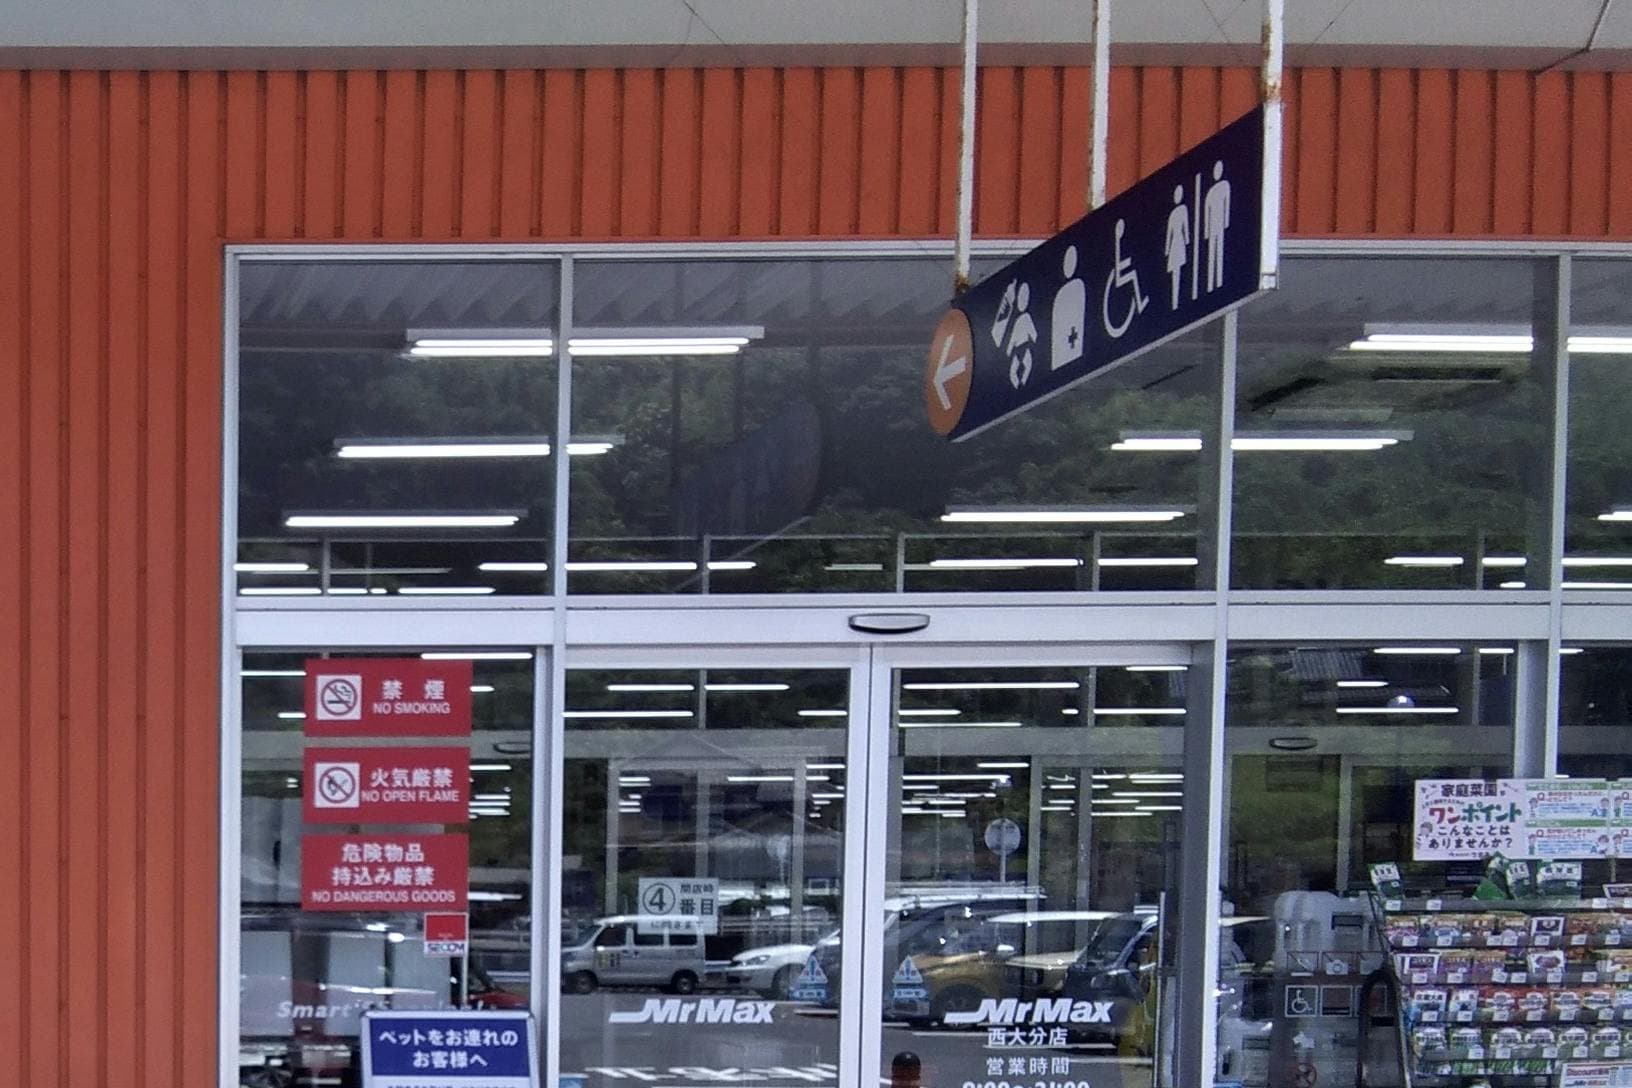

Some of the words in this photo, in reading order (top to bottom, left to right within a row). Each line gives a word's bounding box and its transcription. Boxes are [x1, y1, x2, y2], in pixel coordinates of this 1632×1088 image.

[381, 679, 445, 700] 禁煙
[372, 702, 391, 715] NO
[393, 703, 451, 715] SMOKING
[370, 767, 453, 789] 火気厳禁
[361, 790, 380, 802] NO
[382, 790, 417, 802] OPEN
[419, 790, 460, 802] FLAME
[1428, 801, 1523, 824] ワンポイント
[1437, 825, 1511, 837] こんなことは
[341, 843, 425, 863] 危険物品
[1428, 837, 1513, 849] ありませんか？
[331, 866, 434, 886] 持込み厳禁
[311, 891, 331, 903] NO
[333, 891, 410, 903] DANGEROUS
[412, 891, 456, 903] GOODS
[679, 883, 714, 894] 開店時
[679, 898, 714, 916] 番目
[608, 998, 776, 1026] MrMax
[944, 998, 1112, 1026] MrMax
[379, 1028, 519, 1048] ペットをお連れの
[987, 1027, 1068, 1047] 西大分店
[412, 1050, 488, 1069] お客様へ
[986, 1056, 1070, 1077] 営業時間
